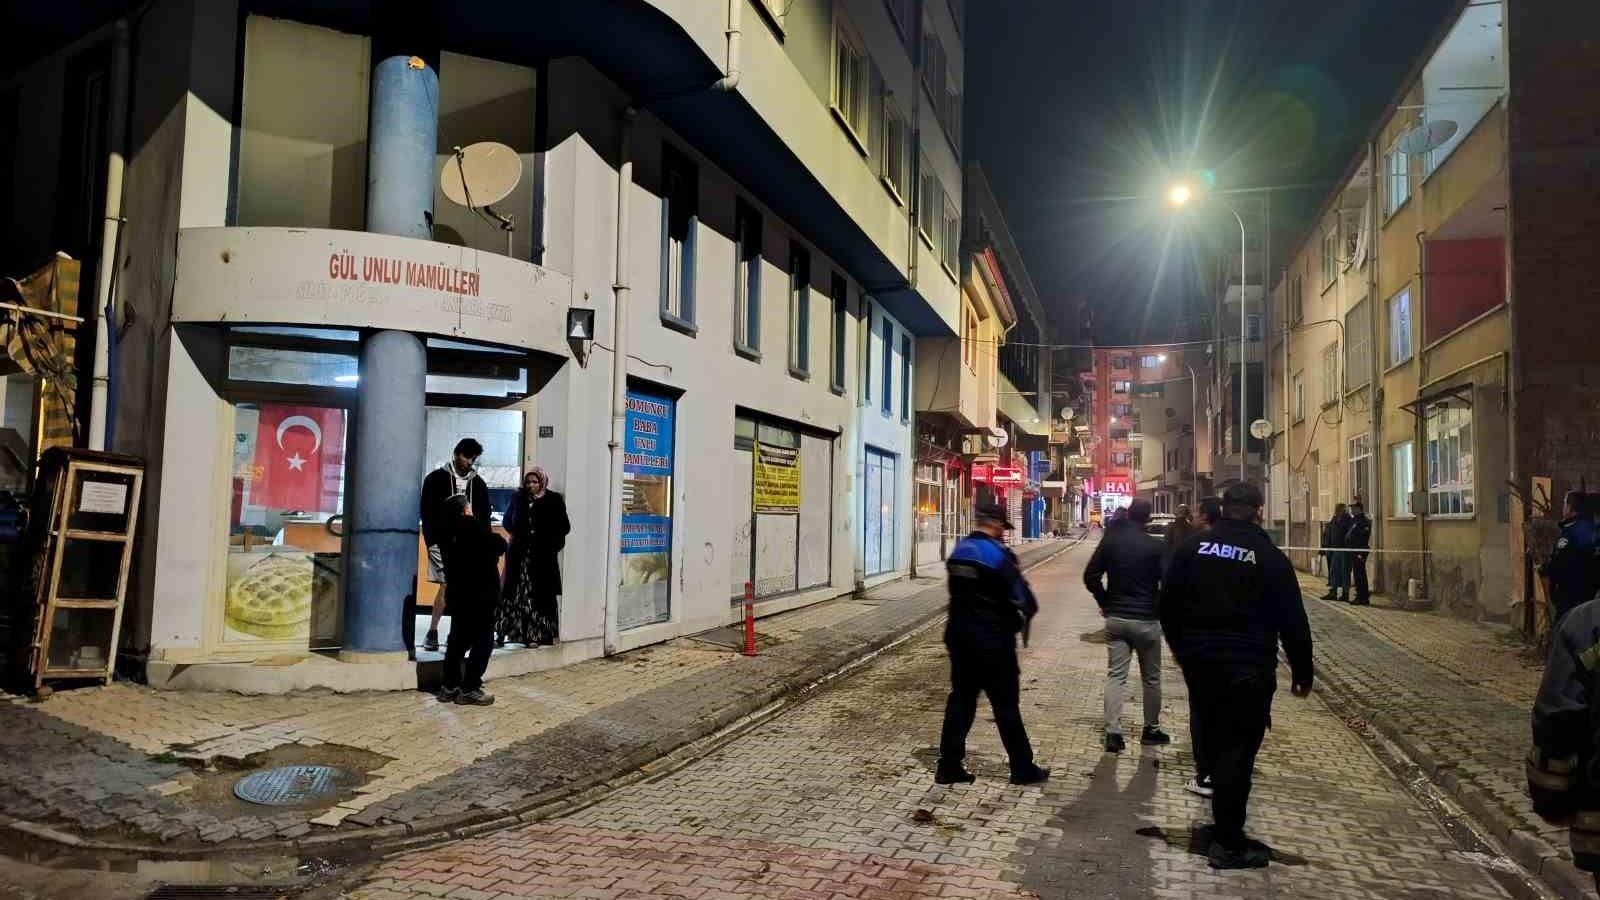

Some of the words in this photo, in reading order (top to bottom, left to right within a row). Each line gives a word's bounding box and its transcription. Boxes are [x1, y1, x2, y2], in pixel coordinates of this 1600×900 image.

[329, 250, 358, 281] GÜL
[363, 255, 401, 285] UNLU
[405, 261, 481, 297] MAMÜLLERİ
[1197, 541, 1257, 565] ZABITA
